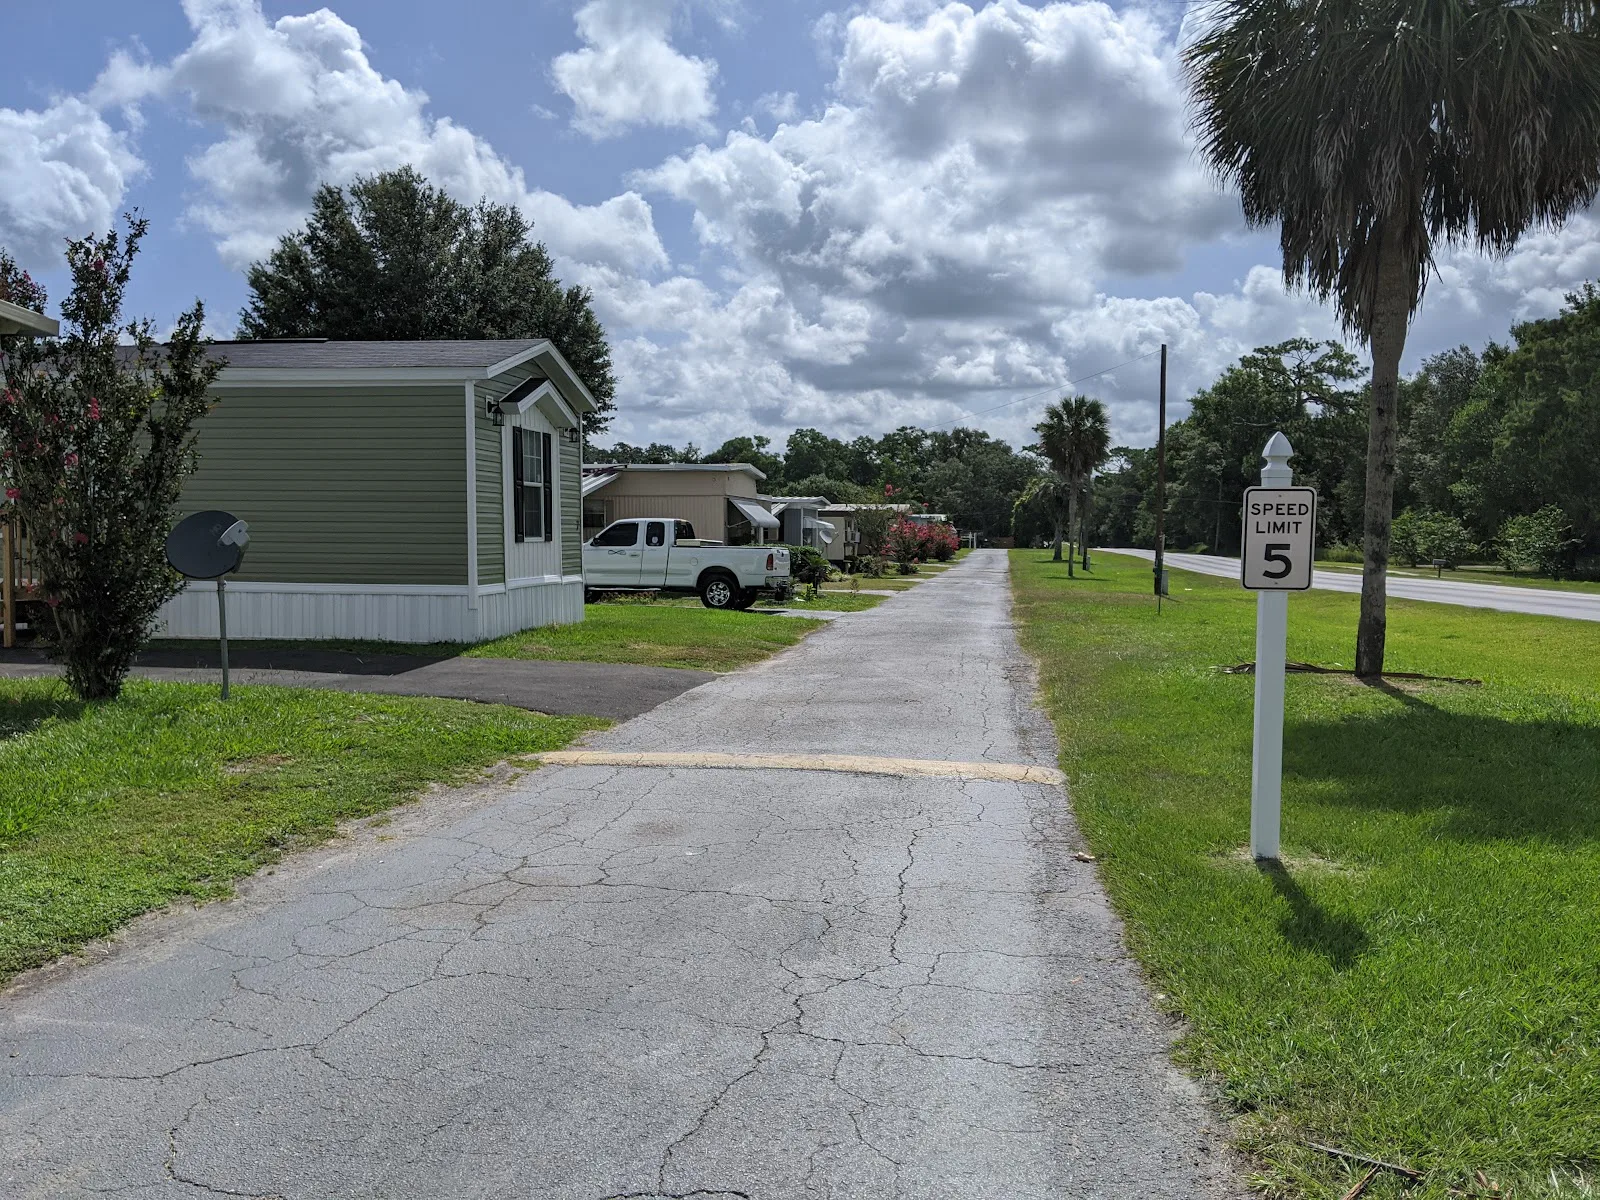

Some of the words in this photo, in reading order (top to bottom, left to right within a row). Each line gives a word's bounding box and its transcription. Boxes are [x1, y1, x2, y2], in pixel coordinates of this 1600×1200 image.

[1250, 503, 1309, 516] SPEED
[1255, 521, 1303, 534] LIMIT
[1262, 543, 1292, 579] 5
